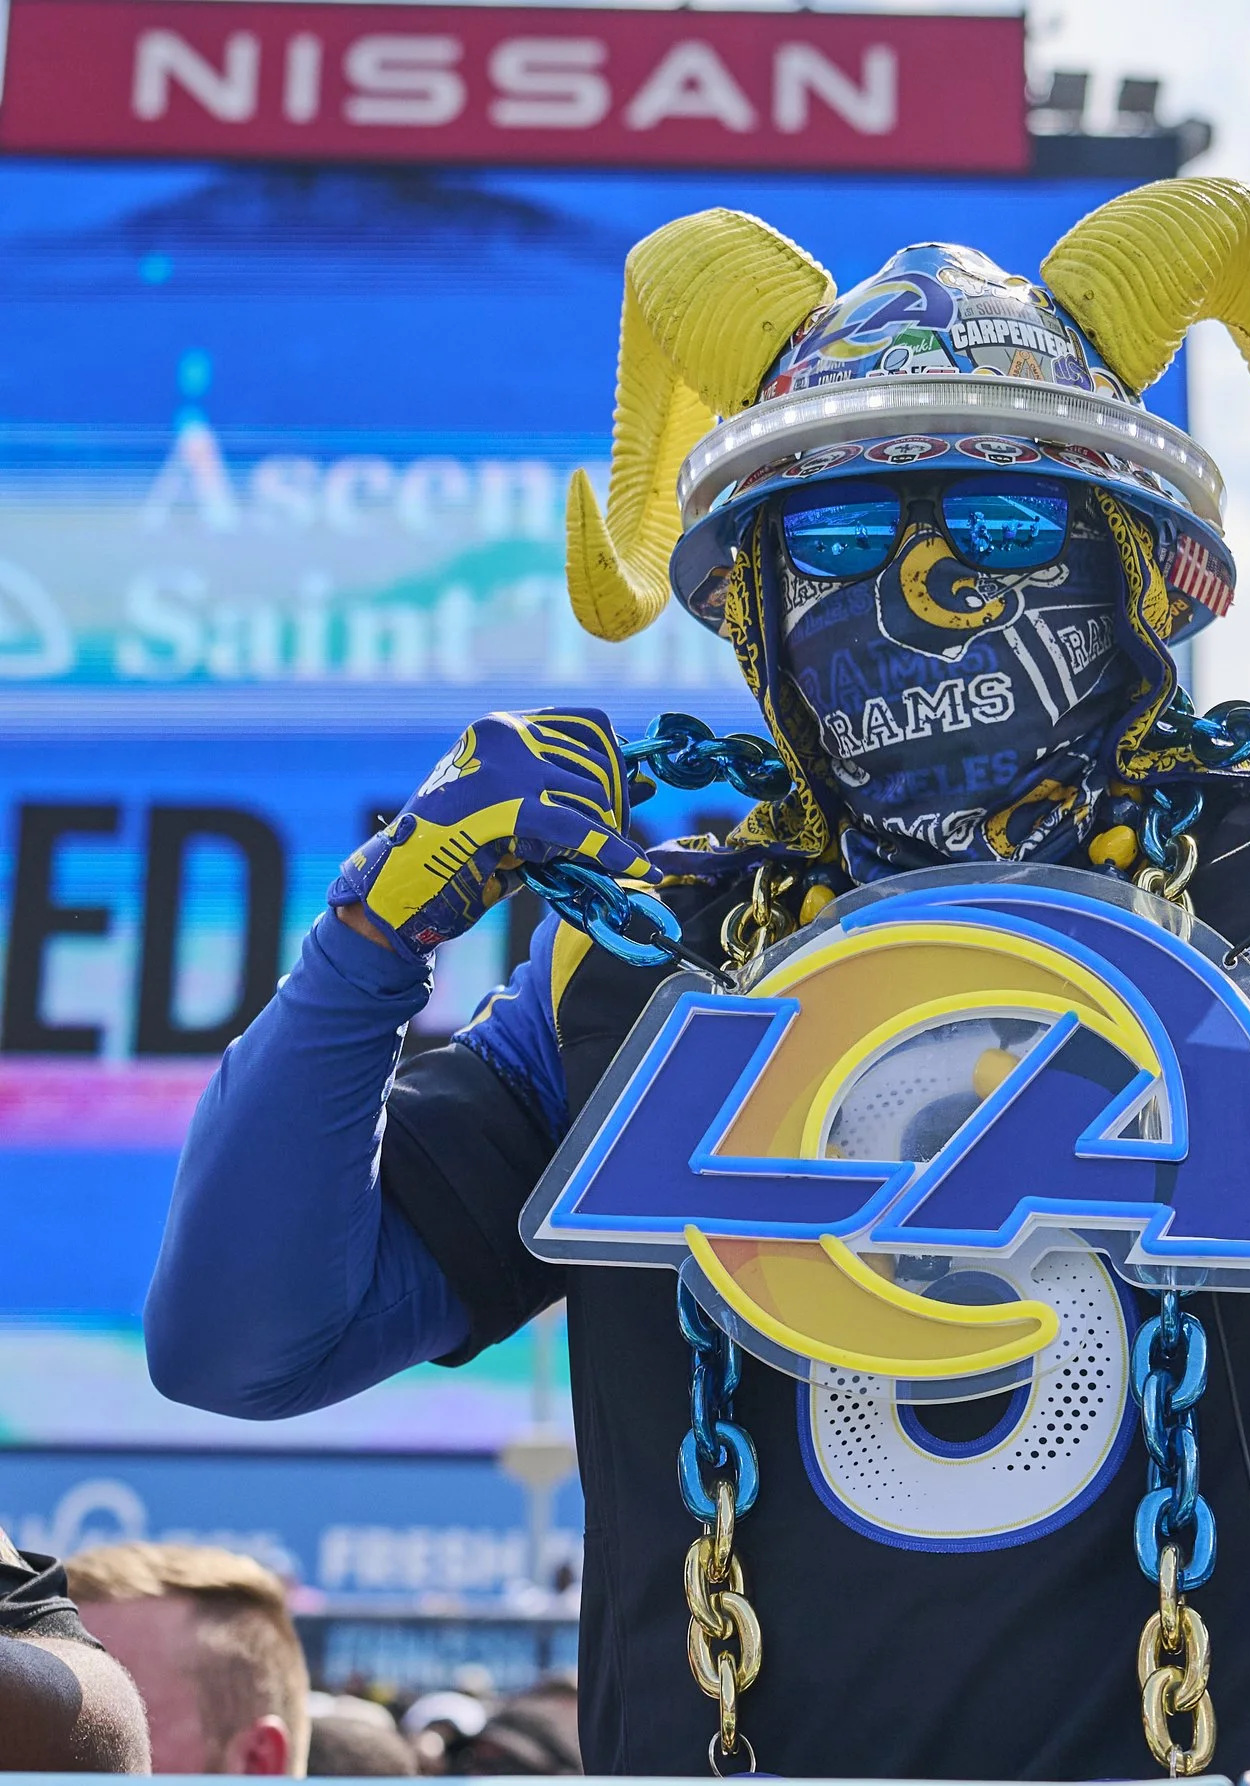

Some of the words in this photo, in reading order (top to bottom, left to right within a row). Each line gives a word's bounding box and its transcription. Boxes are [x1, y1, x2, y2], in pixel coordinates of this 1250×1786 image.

[130, 27, 900, 137] NISSAN
[818, 370, 852, 386] UNION
[138, 420, 574, 536] Ascen
[115, 564, 482, 684] Saint
[823, 672, 1016, 760] RAMS
